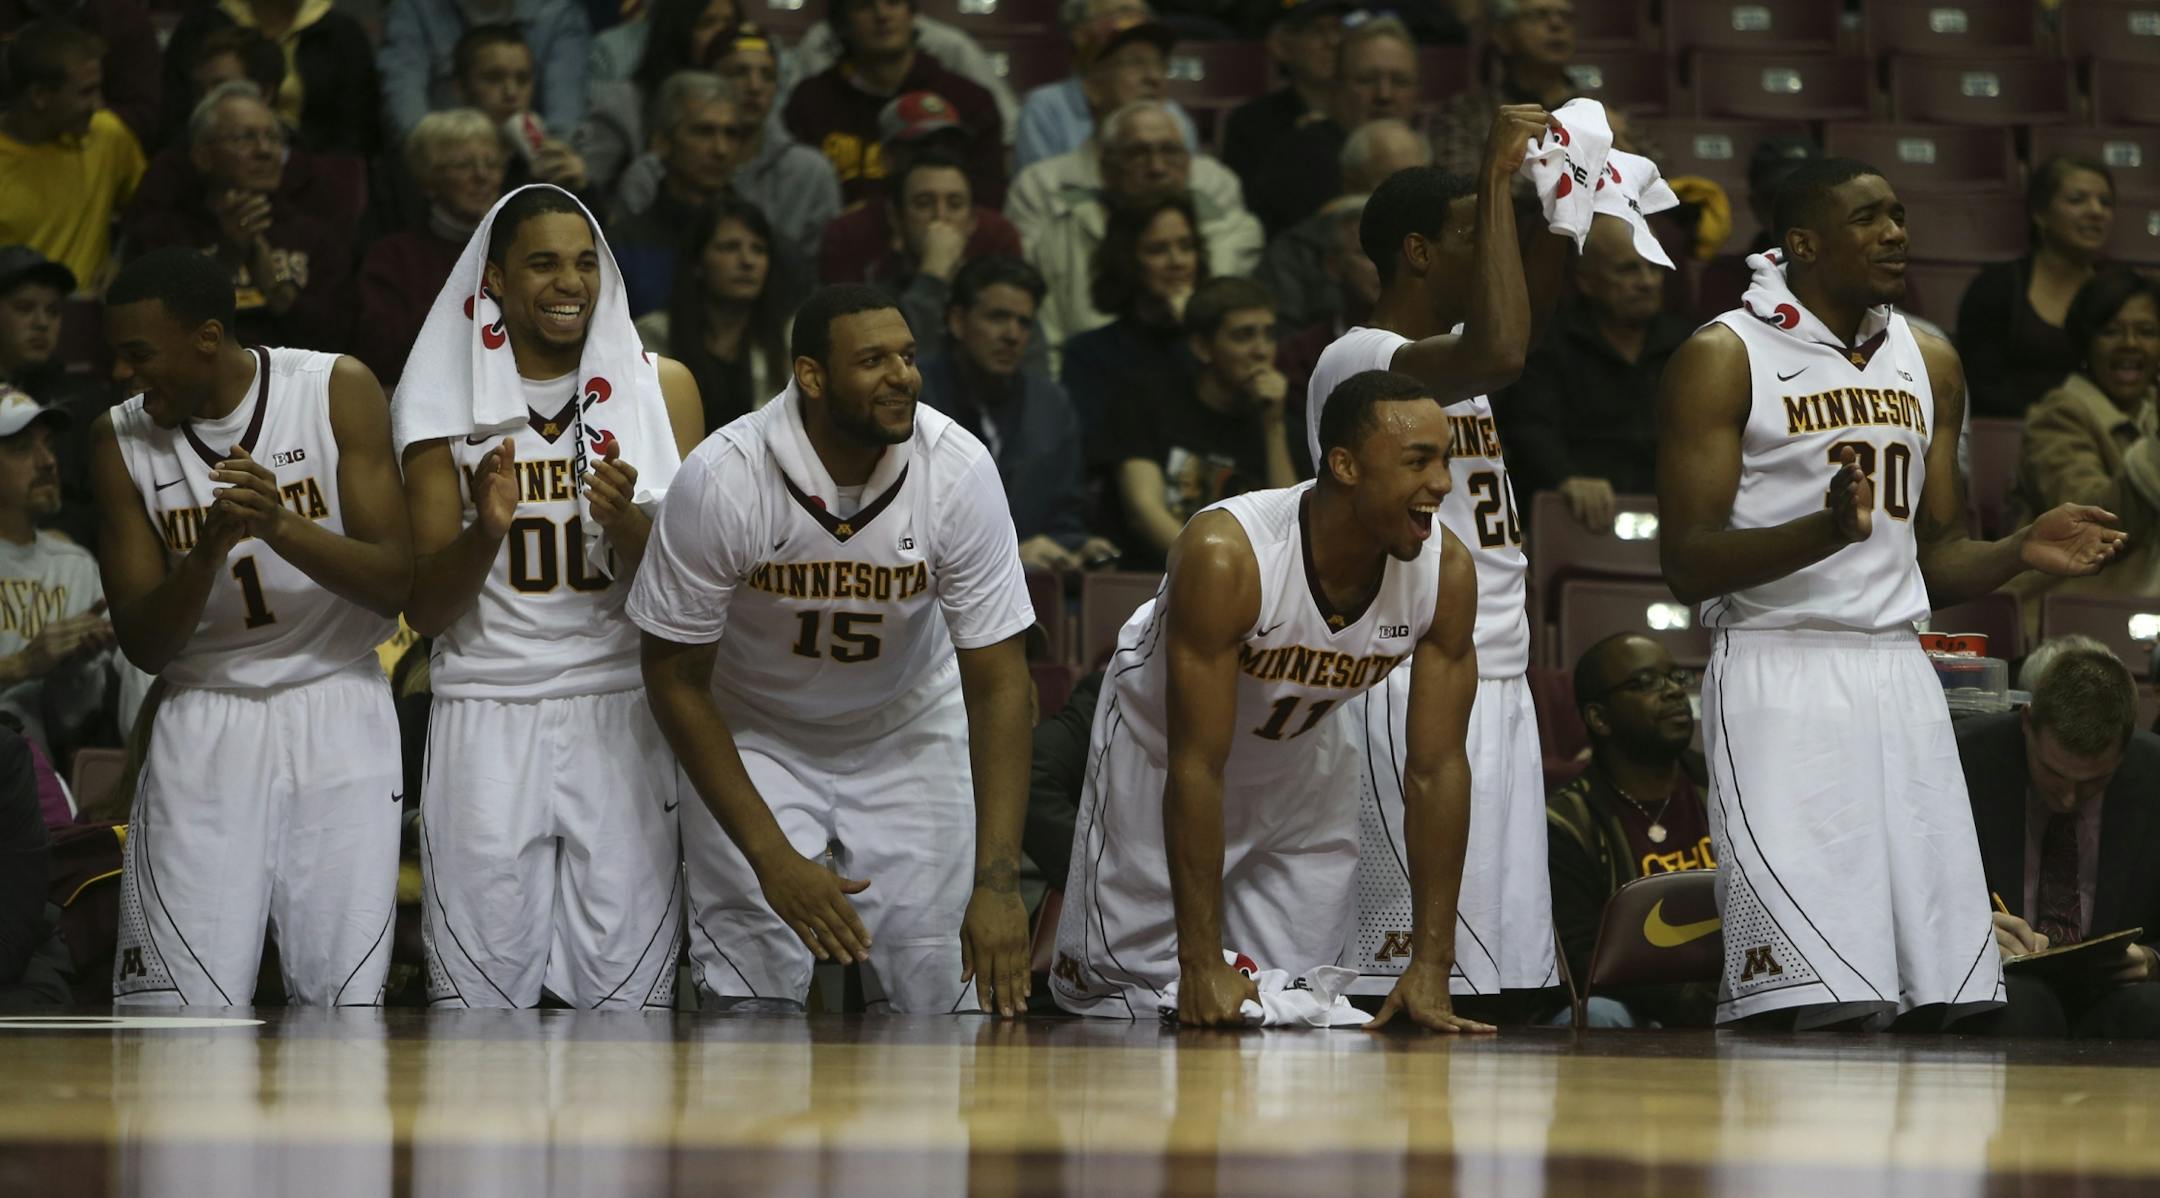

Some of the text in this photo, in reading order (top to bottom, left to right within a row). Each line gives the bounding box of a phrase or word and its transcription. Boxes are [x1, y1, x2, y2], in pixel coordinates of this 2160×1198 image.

[1783, 387, 1928, 437] MINNESOTA
[232, 556, 276, 630] 1
[749, 560, 928, 601] MINNESOTA
[793, 610, 884, 663] 15
[1252, 695, 1338, 741] 11
[1740, 944, 1784, 982] M
